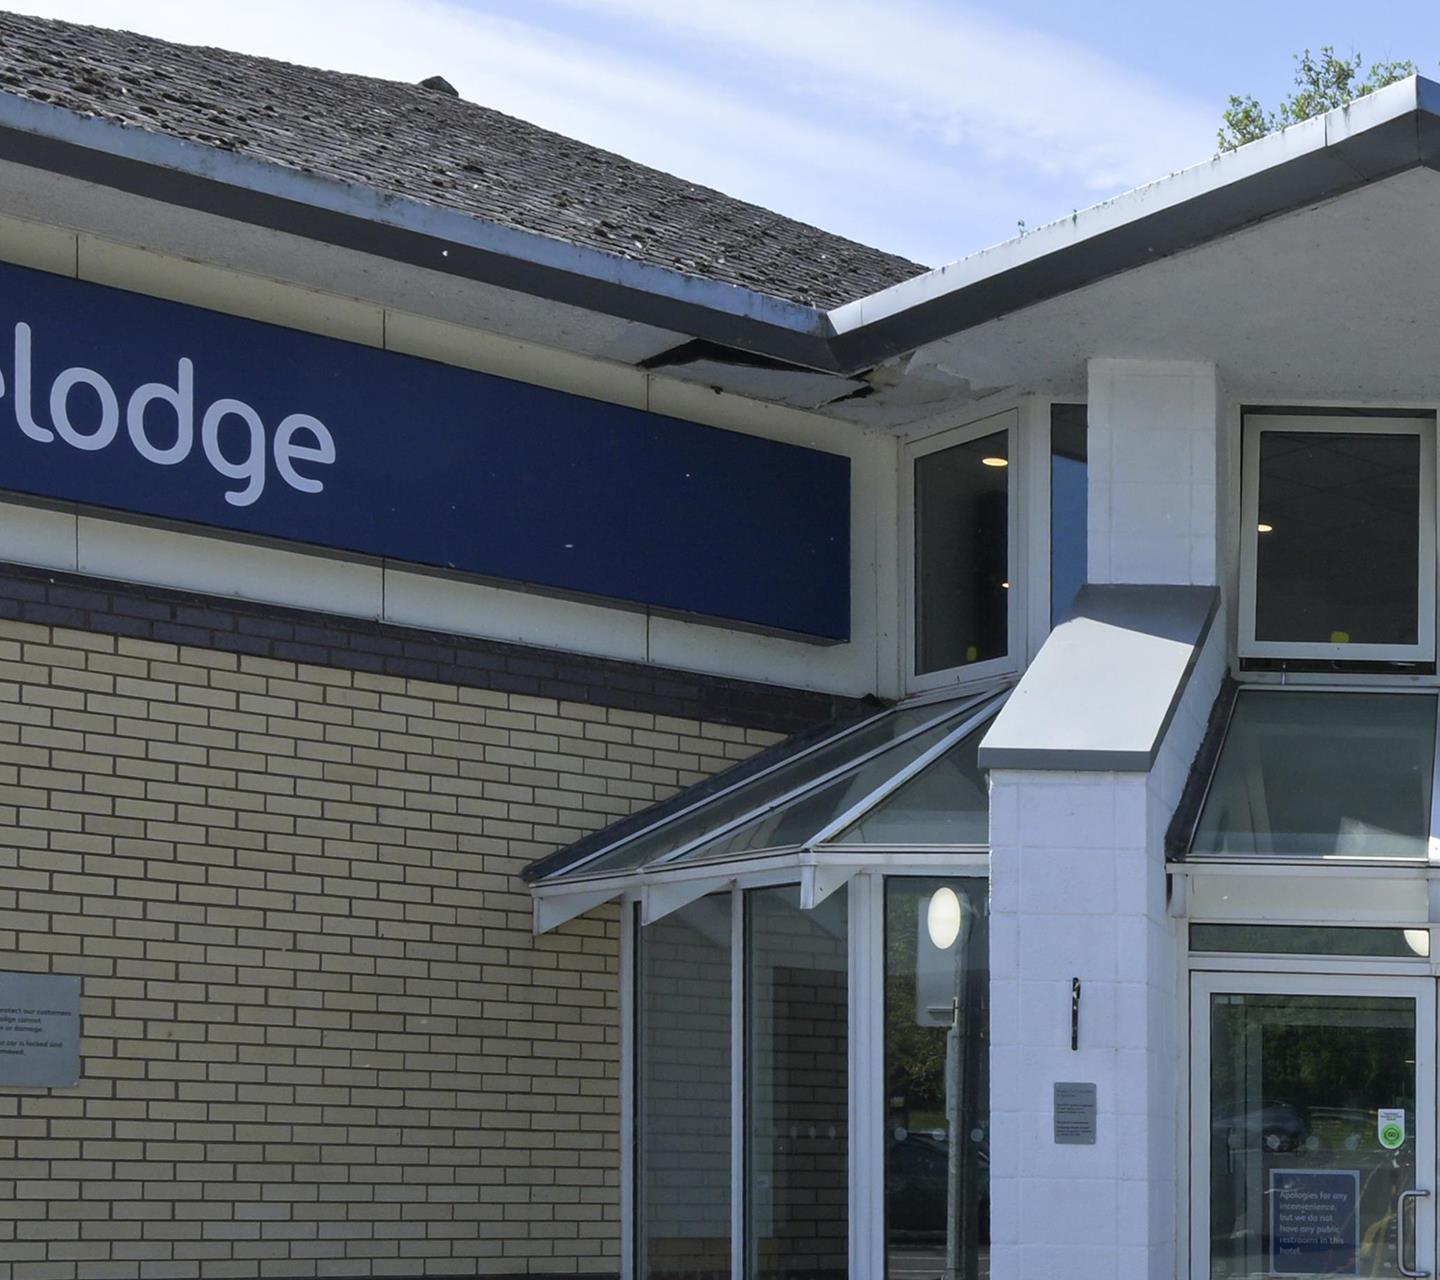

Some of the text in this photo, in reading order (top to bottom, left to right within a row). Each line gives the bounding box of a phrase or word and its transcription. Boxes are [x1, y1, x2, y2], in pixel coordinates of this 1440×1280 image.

[1280, 1191, 1348, 1201] Apologies for any
